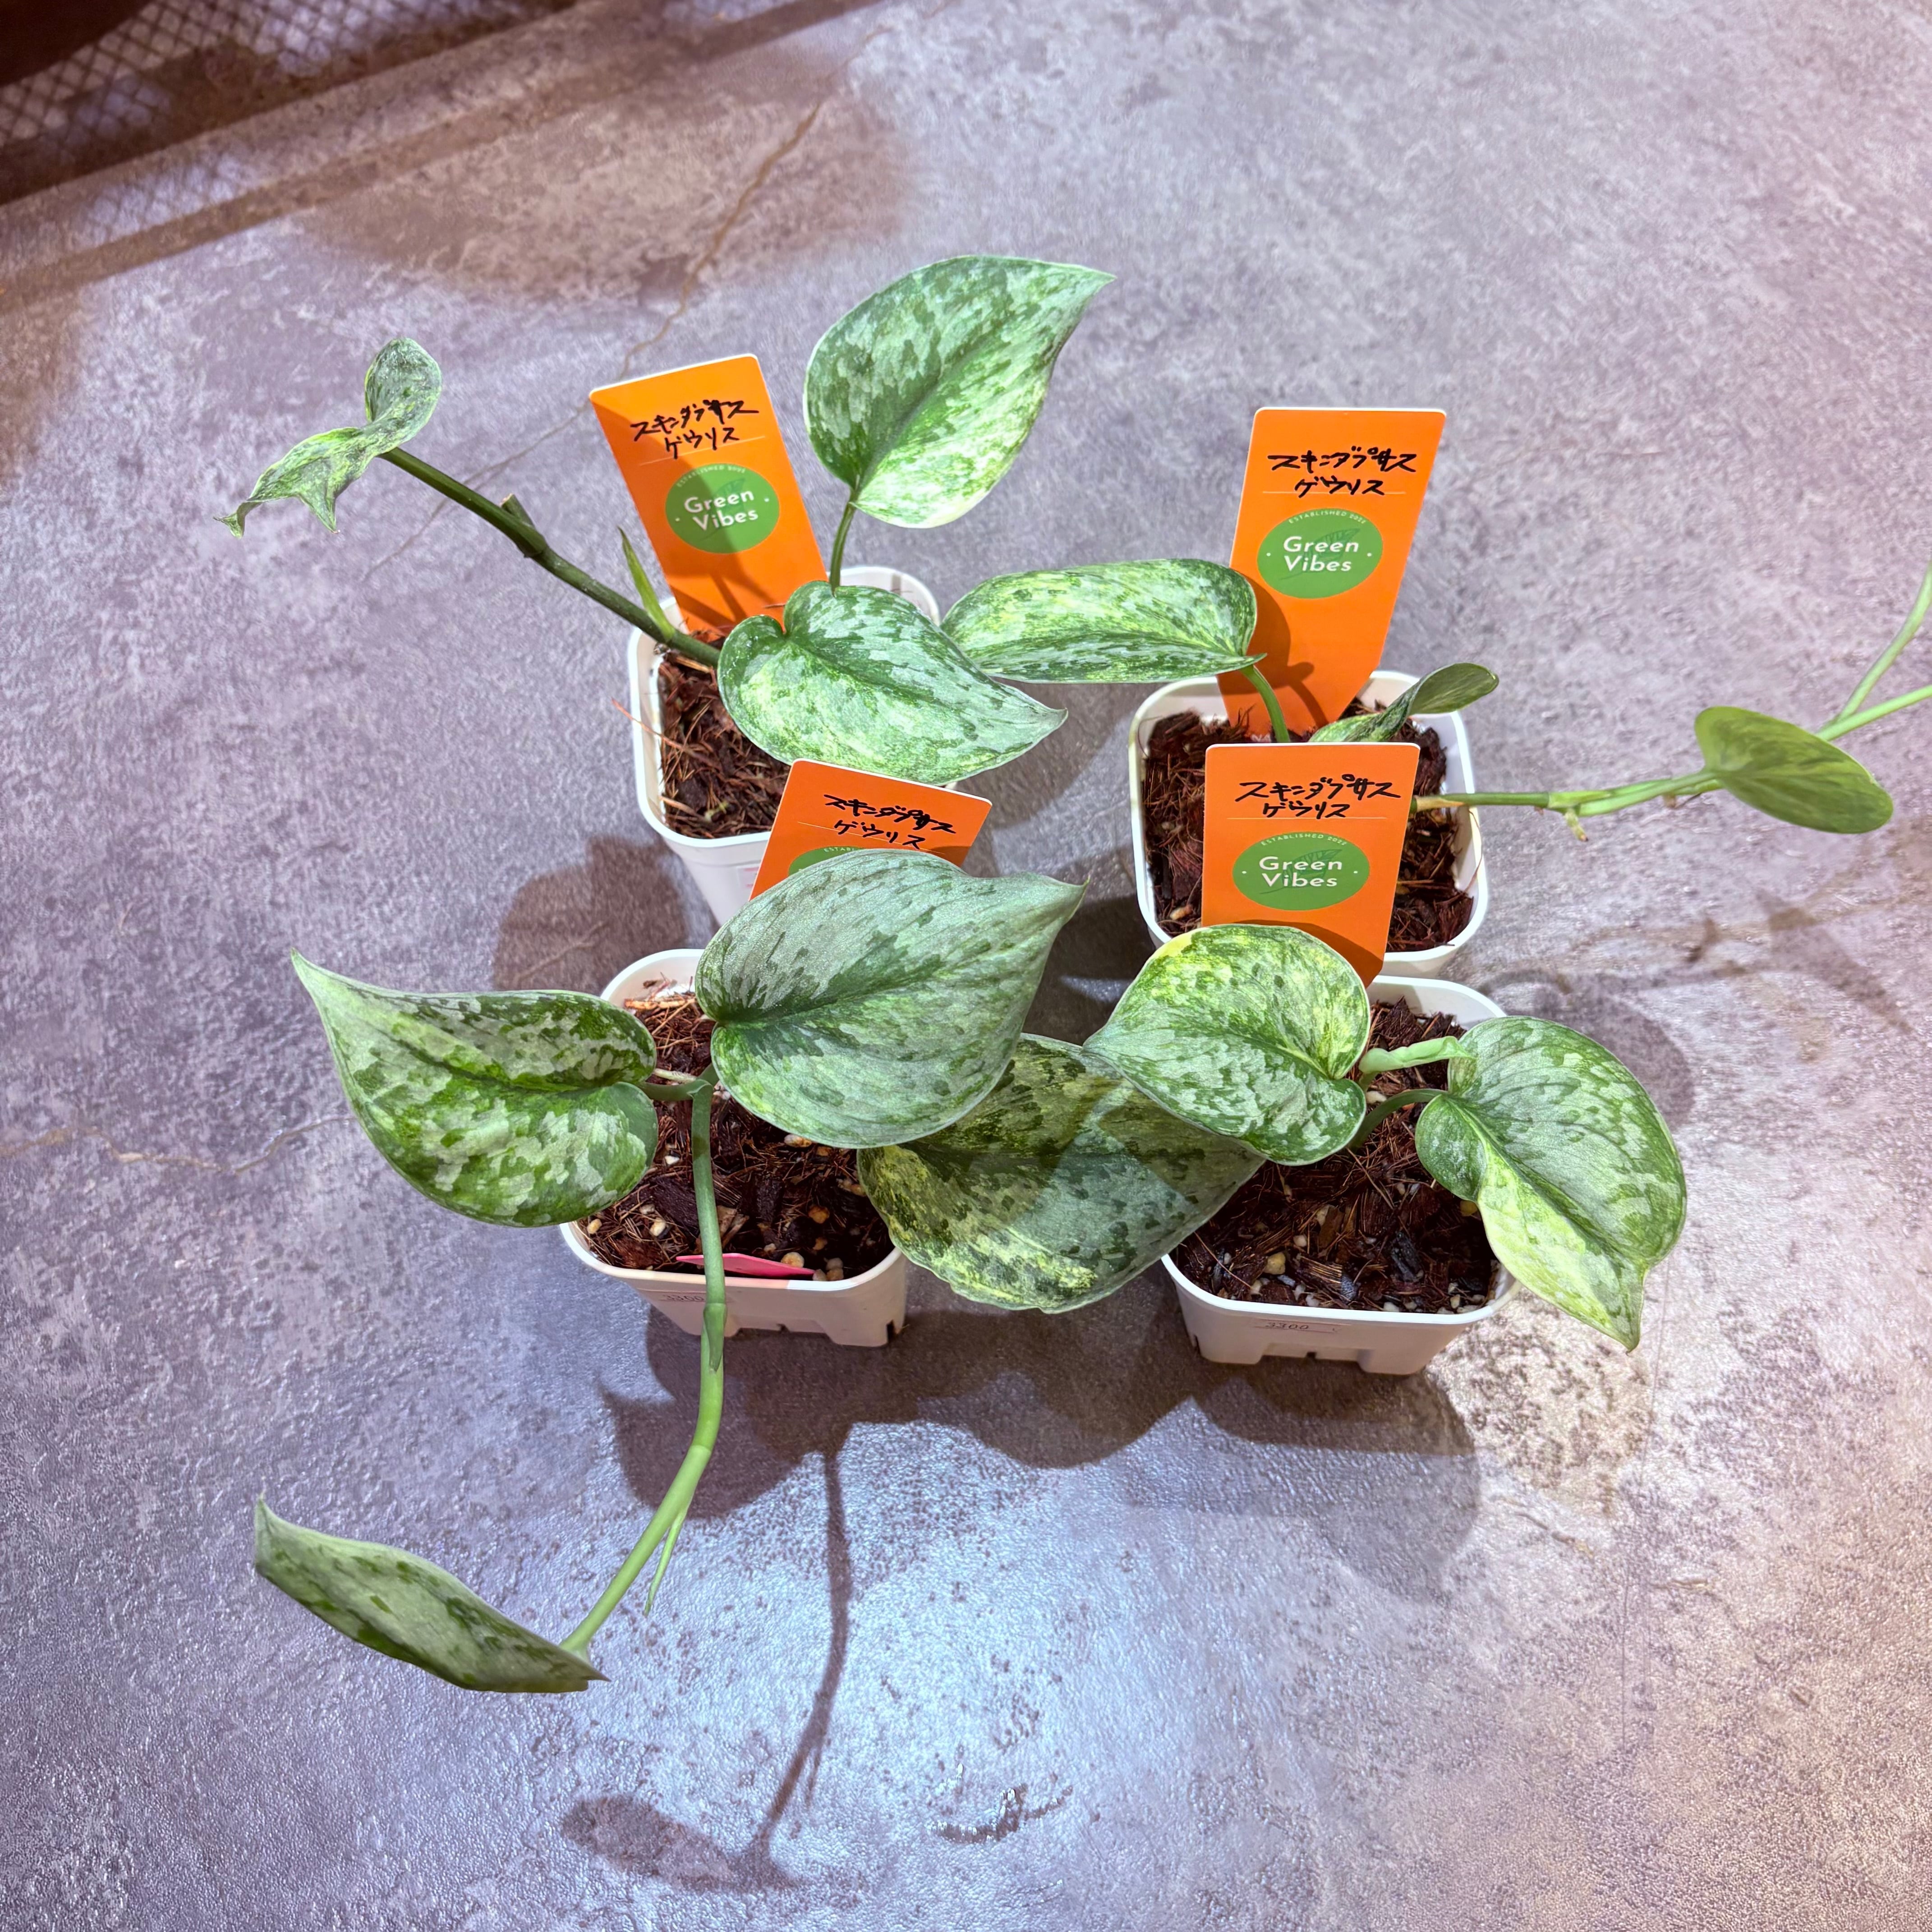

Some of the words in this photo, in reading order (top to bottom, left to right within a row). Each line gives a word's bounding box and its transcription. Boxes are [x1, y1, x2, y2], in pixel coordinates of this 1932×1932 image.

[684, 490, 754, 513] Green
[692, 508, 758, 531] Vibes
[1288, 510, 1347, 524] ESTABLISHED
[1283, 536, 1359, 552] Green
[1283, 555, 1352, 572] Vibes
[1260, 833, 1324, 846] ESTABLISHED
[1259, 856, 1342, 871] Green
[1261, 873, 1338, 887] Vibes
